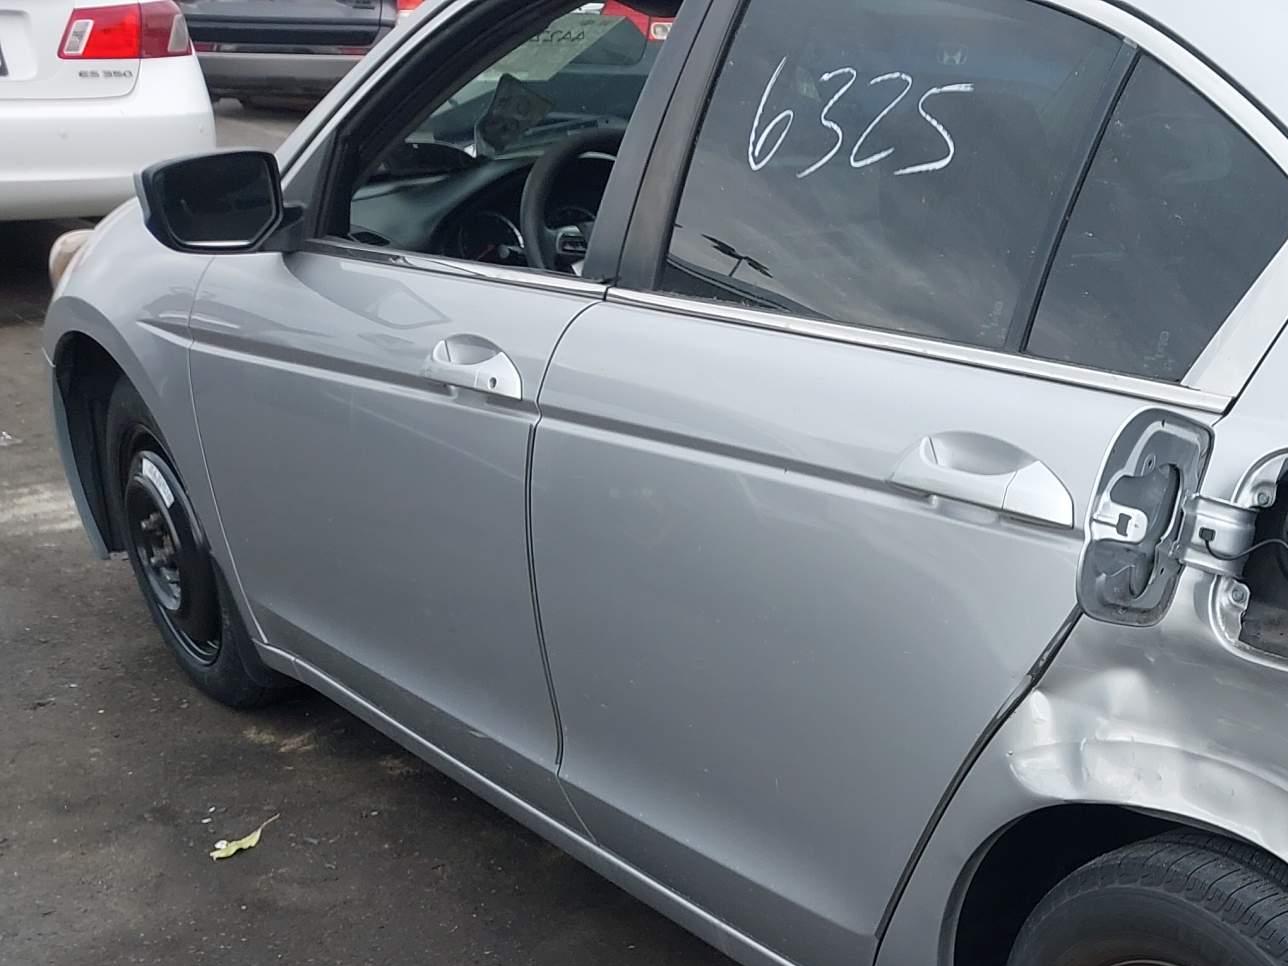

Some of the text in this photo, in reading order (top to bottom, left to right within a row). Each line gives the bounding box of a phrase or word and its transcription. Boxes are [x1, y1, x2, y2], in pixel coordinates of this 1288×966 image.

[78, 70, 133, 78] ES 350
[748, 56, 974, 178] 6325
